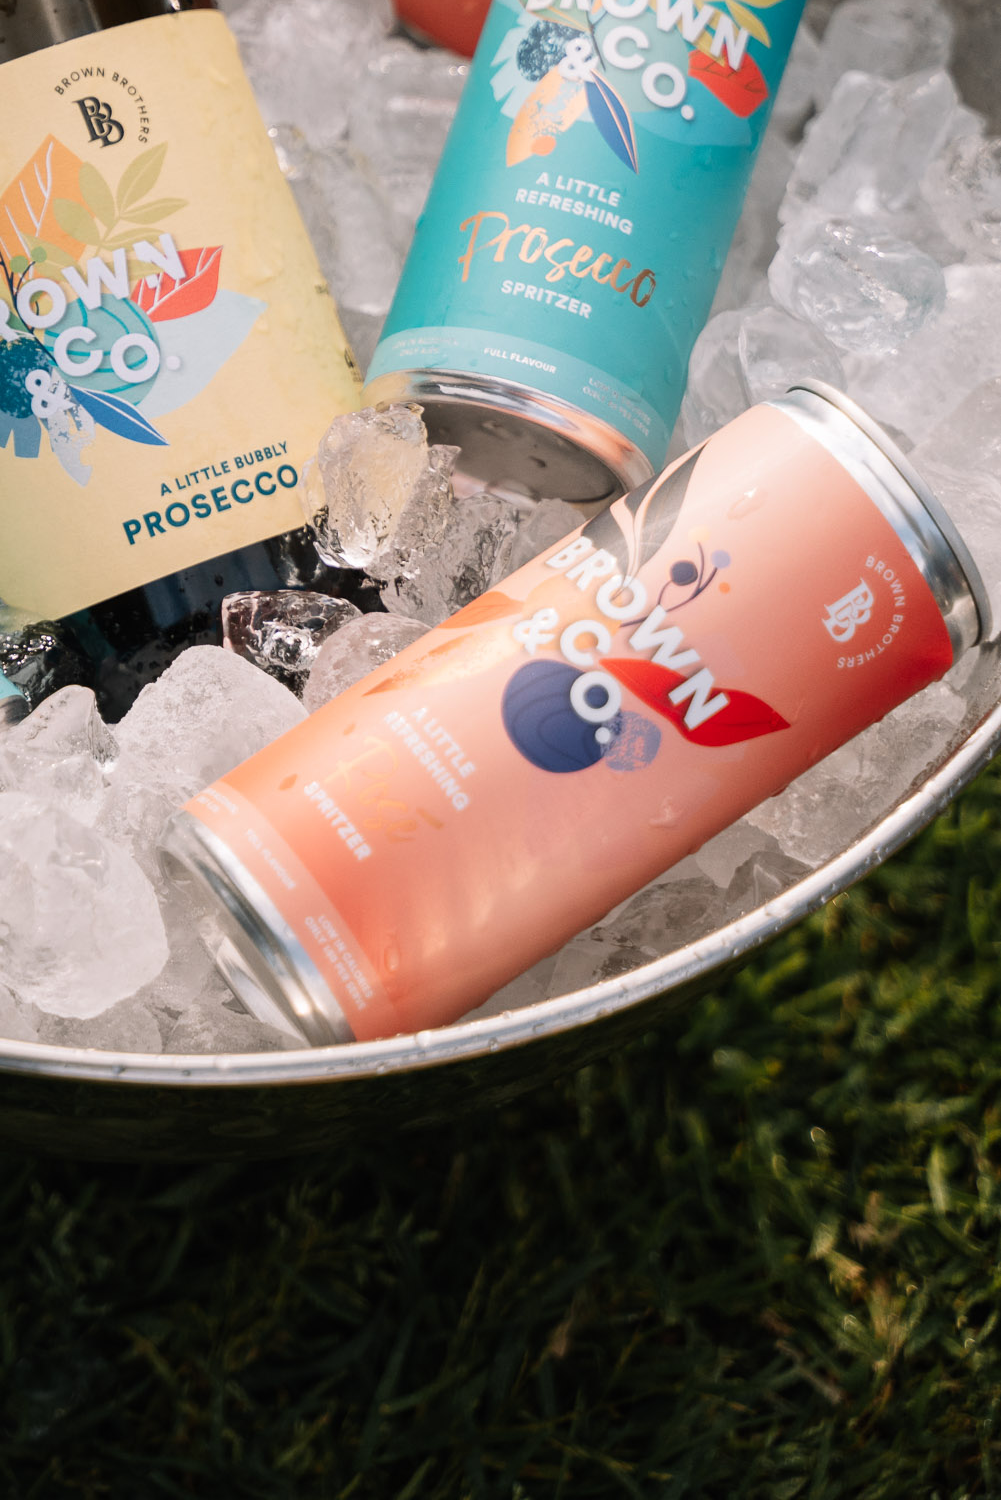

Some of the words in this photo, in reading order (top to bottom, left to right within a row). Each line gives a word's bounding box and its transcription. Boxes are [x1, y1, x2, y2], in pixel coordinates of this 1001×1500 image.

[54, 66, 105, 95] BROWN
[111, 72, 150, 143] BROTHERS
[559, 38, 599, 83] &
[602, 25, 694, 120] CO.
[515, 188, 633, 235] REFRESHING
[536, 172, 549, 187] A
[555, 175, 620, 207] LITTLE
[458, 210, 656, 307] Prosecco
[501, 279, 592, 318] SPRITZER
[25, 369, 75, 419] &
[53, 326, 181, 383] CO.
[484, 347, 507, 360] FULL
[510, 352, 557, 374] FLAVOUR
[122, 464, 298, 545] PROSECCO
[161, 483, 172, 496] A
[175, 461, 231, 490] LITTLE
[234, 441, 288, 469] BUBBLY
[865, 555, 905, 607] BROWN
[545, 536, 730, 731] BROWN
[837, 614, 904, 669] BROTHERS
[513, 607, 559, 656] &
[560, 619, 622, 745] CO.
[384, 710, 470, 811] REFRESHING
[412, 706, 429, 722] A
[423, 717, 476, 779] LITTLE
[304, 781, 372, 861] SPRITZER
[317, 914, 338, 940] LOW
